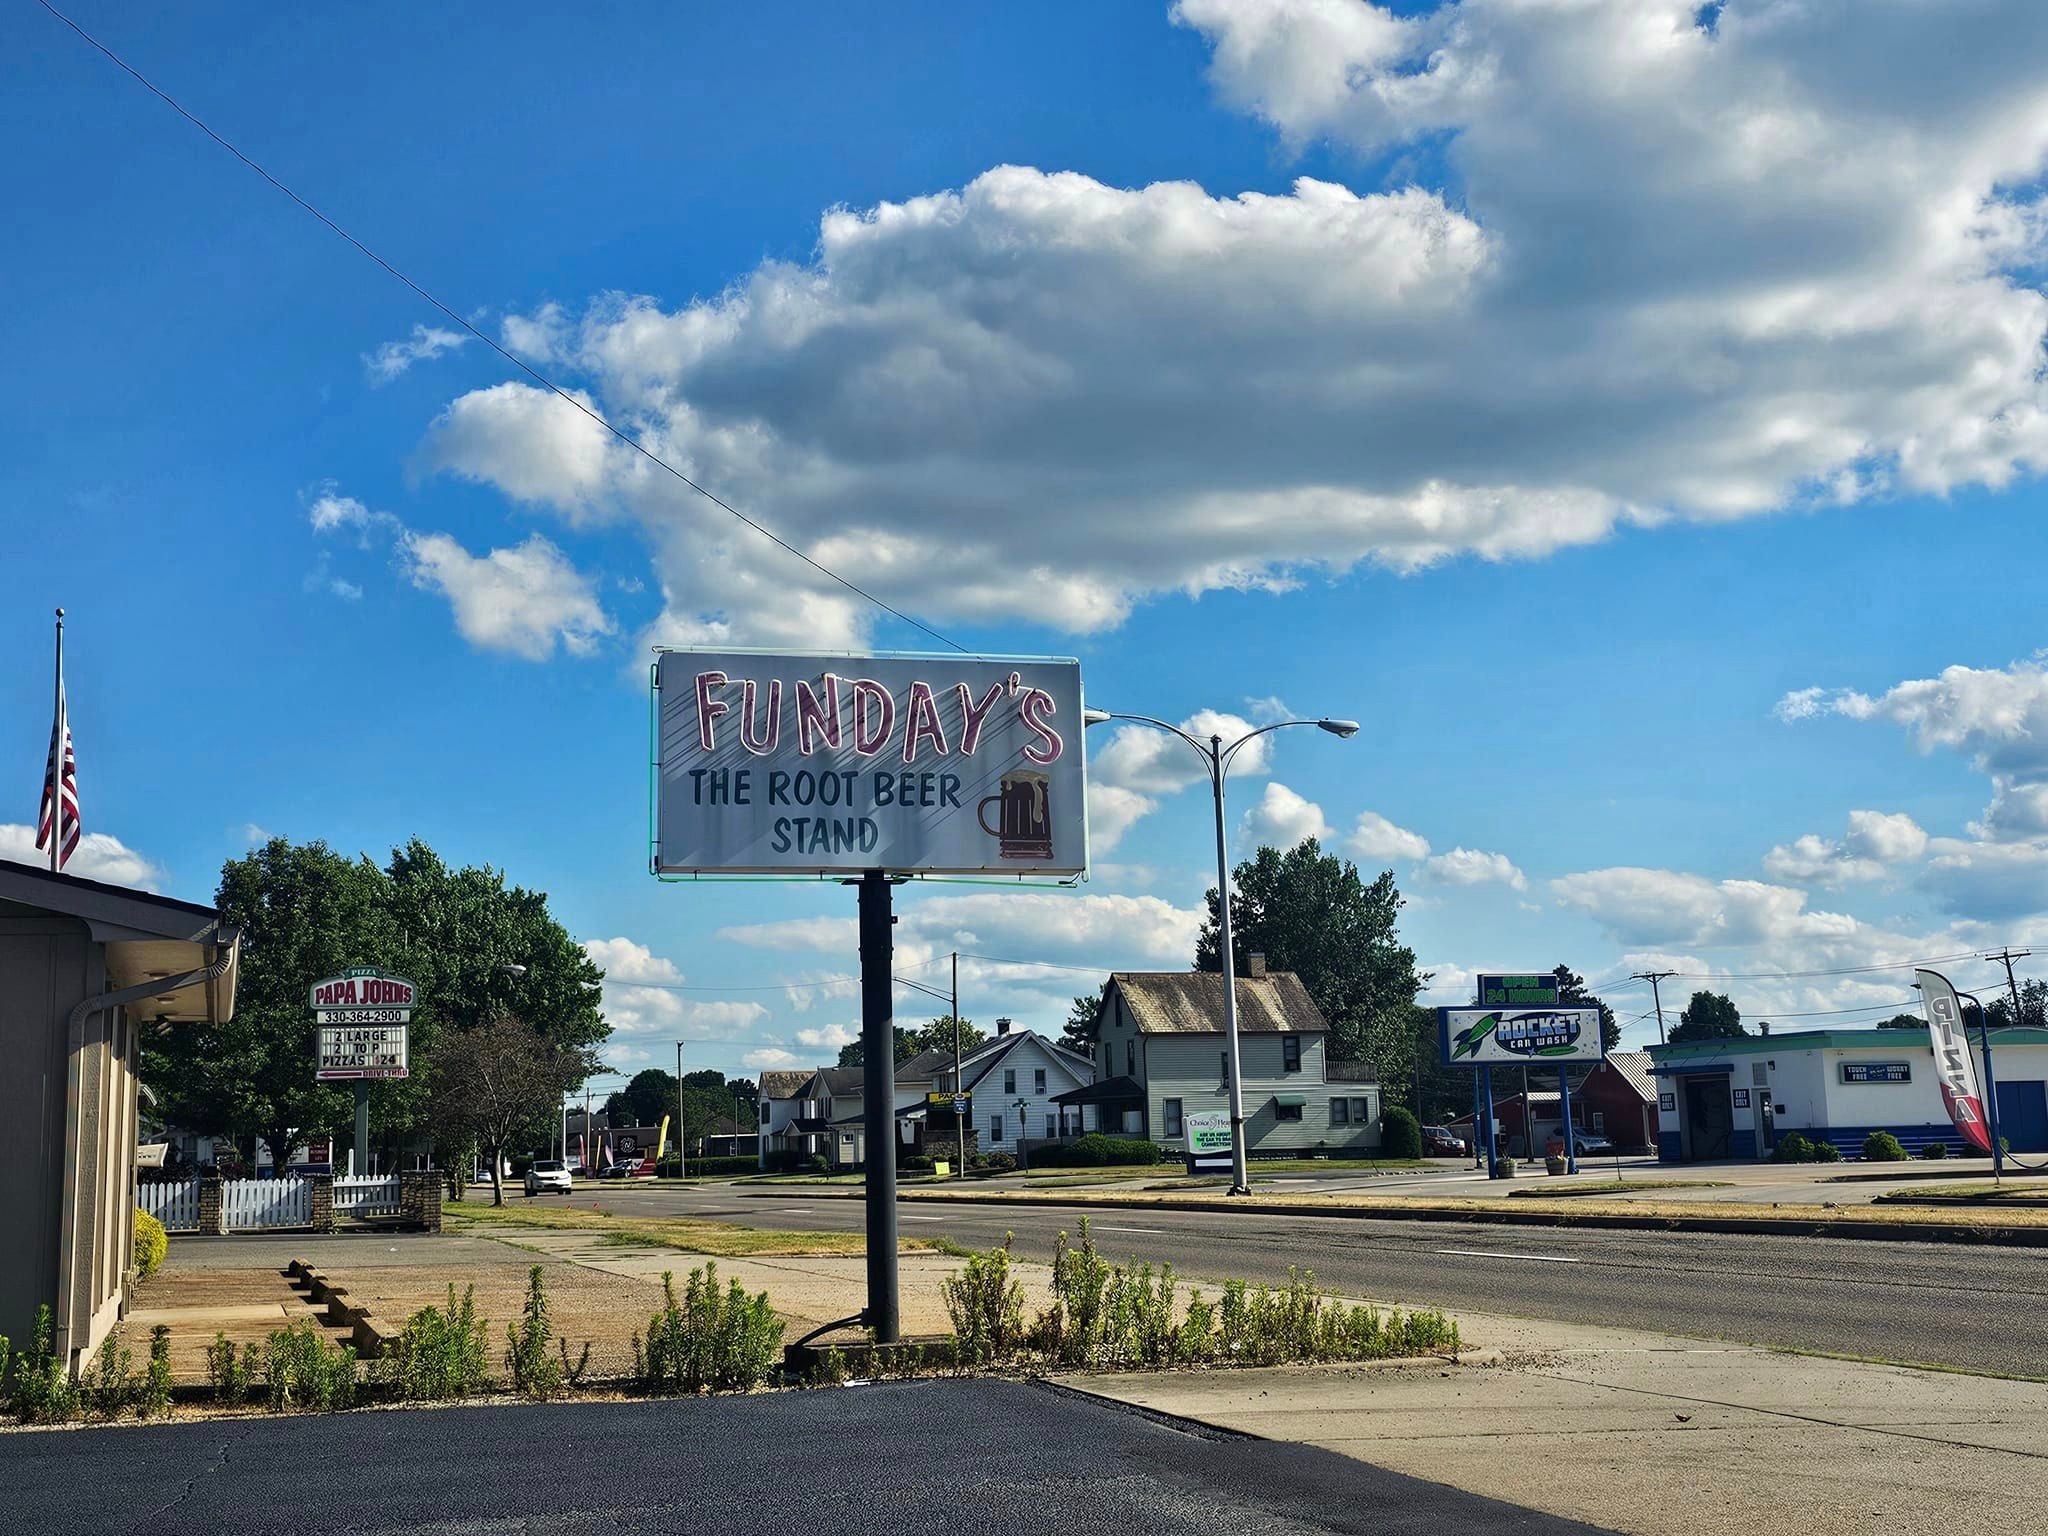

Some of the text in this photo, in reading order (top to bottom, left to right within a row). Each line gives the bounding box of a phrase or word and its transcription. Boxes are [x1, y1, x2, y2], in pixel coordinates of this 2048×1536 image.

[694, 671, 1064, 765] FUNDAY'S
[689, 769, 961, 808] THE ROOT BEER
[771, 816, 879, 854] STAND
[351, 968, 377, 976] PIZZA
[1503, 976, 1540, 988] OPEN
[315, 980, 412, 1005] PAPA JOHNS
[1487, 989, 1556, 1003] 24 HOURS
[325, 1011, 402, 1022] 330-364-2900
[1498, 1014, 1579, 1041] ROCKET
[335, 1031, 388, 1042] 2 LARGE
[1510, 1035, 1568, 1049] CAR WASH
[334, 1044, 341, 1054] 2
[322, 1056, 366, 1066] PIZZAS
